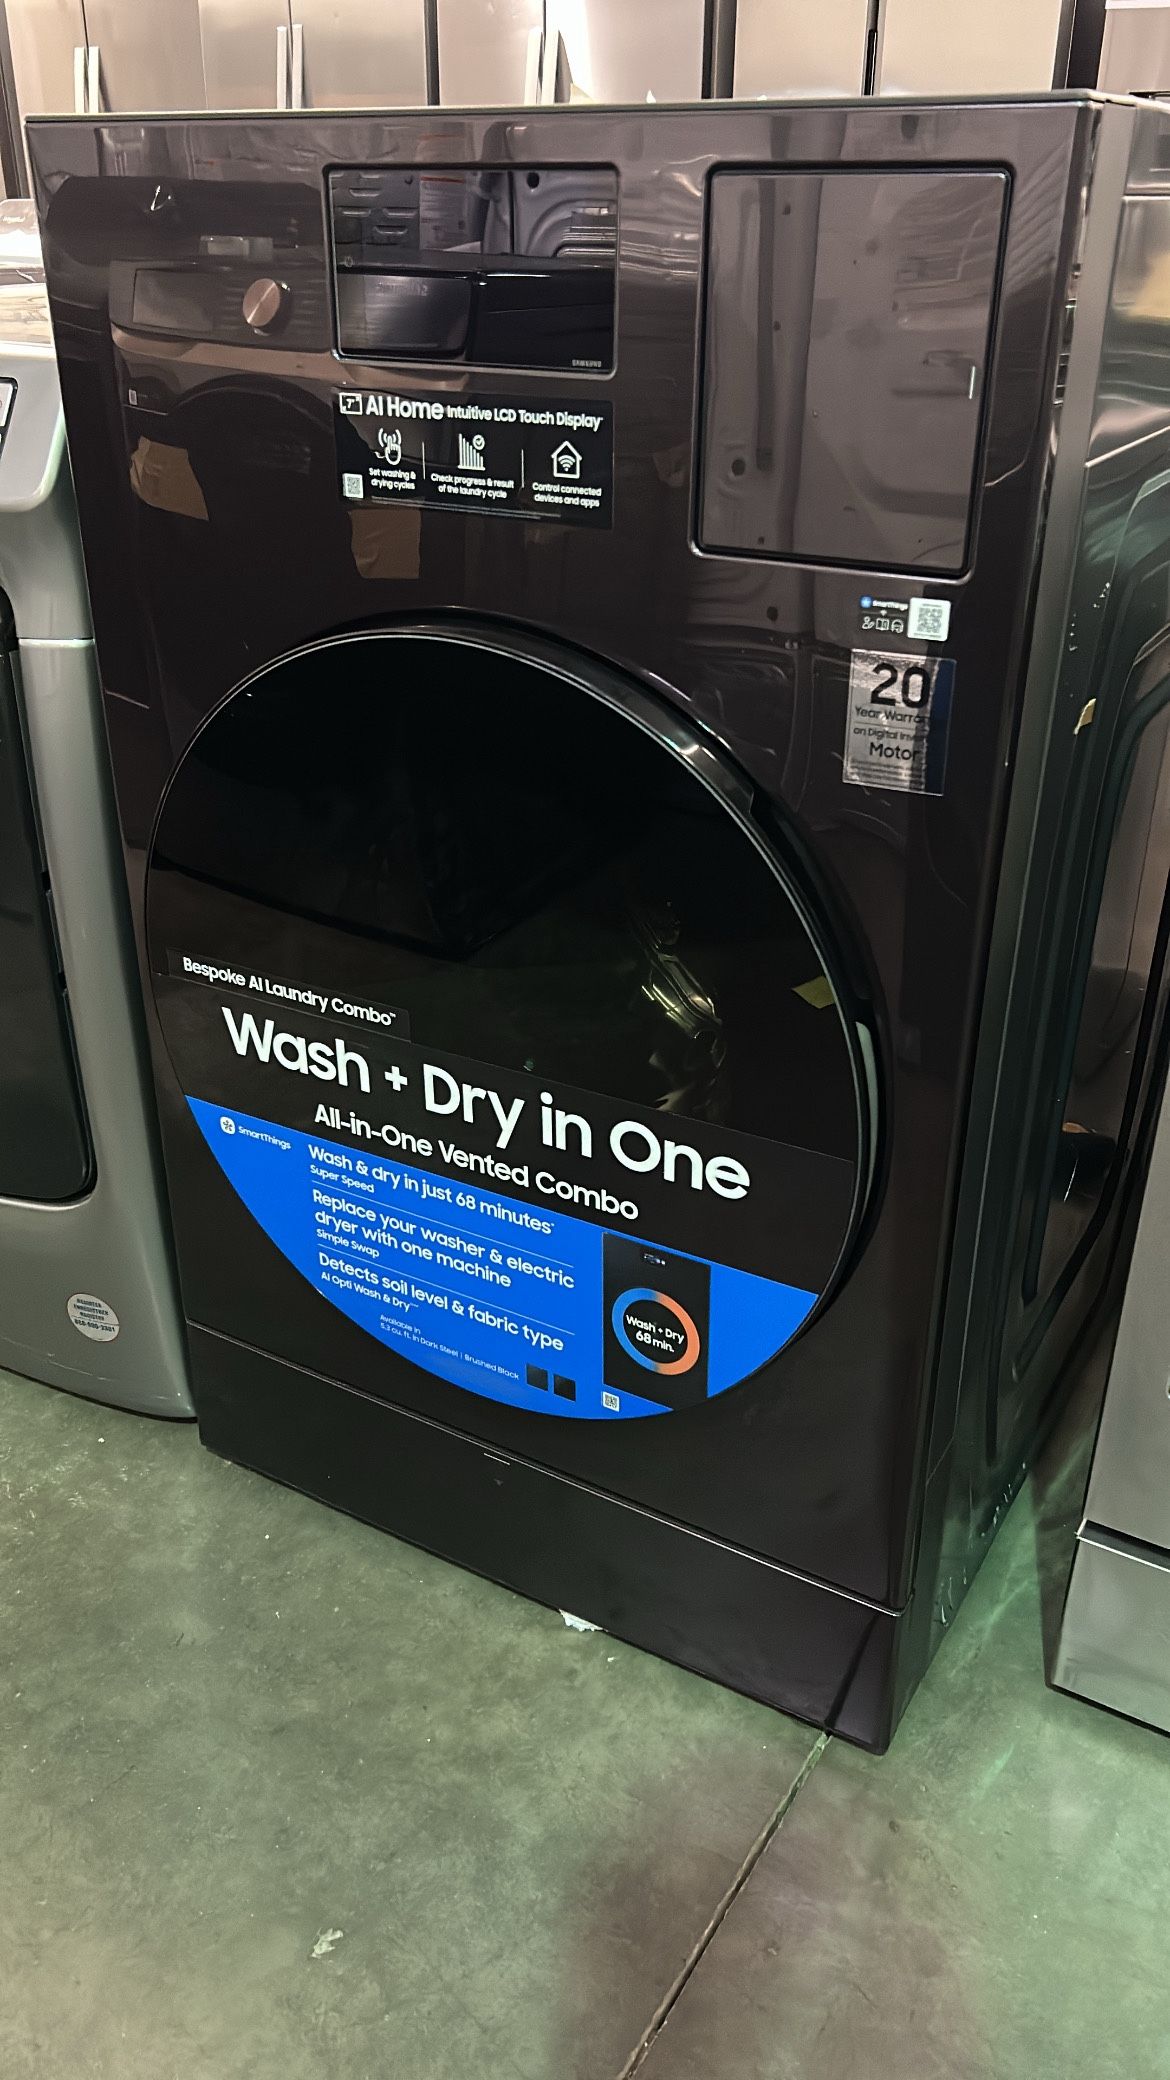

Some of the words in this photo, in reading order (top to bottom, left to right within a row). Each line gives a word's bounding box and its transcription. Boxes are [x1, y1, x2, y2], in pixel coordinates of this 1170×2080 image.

[366, 395, 384, 416] AI
[386, 396, 445, 420] Home
[446, 404, 493, 421] Intuitive
[494, 408, 517, 422] LCD
[518, 409, 555, 425] Touch
[369, 467, 381, 478] Set
[381, 469, 410, 481] washing
[371, 478, 393, 490] drying
[394, 480, 416, 491] cycles
[430, 472, 453, 484] Check
[454, 475, 486, 488] progress
[494, 478, 515, 489] result
[438, 483, 446, 493] of
[447, 485, 459, 495] the
[460, 486, 487, 499] laundry
[487, 489, 508, 500] cycle
[532, 482, 560, 492] Control
[560, 484, 602, 497] connected
[534, 493, 563, 504] devices
[563, 496, 580, 506] and
[580, 498, 600, 509] apps
[871, 663, 931, 708] 20
[855, 706, 881, 720] Year
[853, 727, 866, 736] on
[868, 728, 899, 740] Digital
[869, 742, 920, 761] Motor
[183, 956, 246, 986] Bespoke
[249, 975, 264, 992] AI
[265, 979, 329, 1013] Laundry
[221, 1006, 371, 1093] Wash
[384, 1066, 408, 1091] +
[423, 1063, 526, 1149] Dry
[540, 1091, 592, 1158] in
[609, 1120, 750, 1200] One
[238, 1126, 292, 1150] SmartThings
[314, 1104, 433, 1157] All-in-One
[438, 1140, 529, 1188] Vented
[535, 1171, 640, 1220] Combo
[308, 1144, 353, 1172] Wash
[356, 1160, 369, 1176] &
[372, 1167, 401, 1190] dry
[404, 1174, 419, 1192] in
[421, 1180, 452, 1204] just
[455, 1191, 477, 1210] 68
[310, 1164, 339, 1182] Super
[341, 1175, 375, 1193] Speed
[312, 1189, 376, 1222] Replace
[380, 1214, 417, 1235] your
[420, 1227, 486, 1258] washer
[489, 1248, 503, 1265] &
[506, 1256, 576, 1289] electric
[315, 1211, 358, 1235] dryer
[361, 1227, 398, 1249] with
[401, 1241, 433, 1260] one
[436, 1253, 512, 1287] machine
[316, 1228, 350, 1246] Simple
[351, 1240, 380, 1259] Swap
[319, 1252, 379, 1285] Detects
[381, 1276, 409, 1295] soil
[411, 1284, 449, 1310] level
[451, 1300, 465, 1316] &
[468, 1304, 519, 1335] fabric
[522, 1325, 564, 1350] type
[321, 1271, 331, 1282] AI
[331, 1276, 353, 1289] Opti
[353, 1283, 382, 1300] Wash
[382, 1294, 391, 1304] &
[380, 1314, 412, 1332] Available
[626, 1314, 656, 1334] Wash
[665, 1328, 685, 1344] Dry
[380, 1322, 391, 1332] 5.3
[420, 1336, 439, 1350] Dark
[439, 1344, 459, 1358] Steel
[464, 1353, 497, 1372] Brushed
[497, 1365, 519, 1381] Black
[635, 1330, 651, 1344] 68
[652, 1336, 675, 1353] min.
